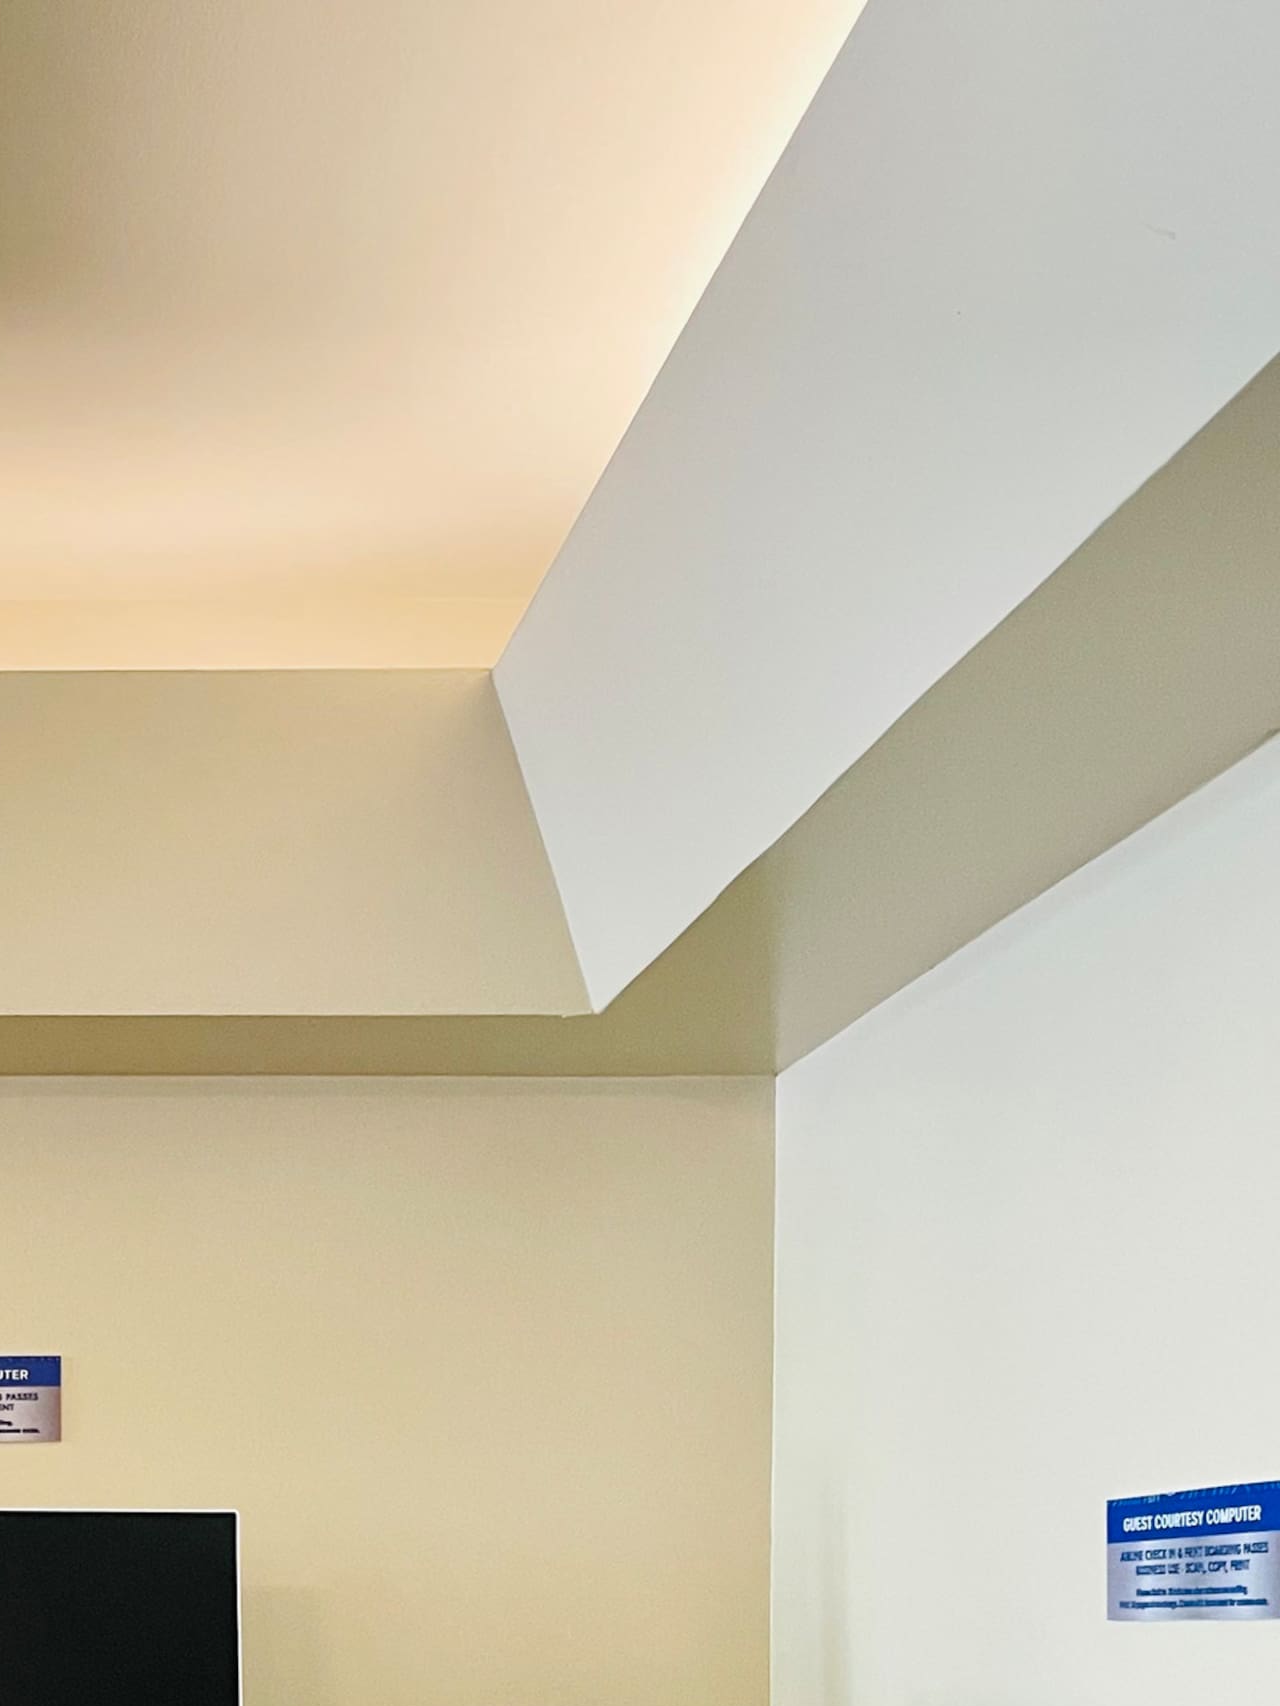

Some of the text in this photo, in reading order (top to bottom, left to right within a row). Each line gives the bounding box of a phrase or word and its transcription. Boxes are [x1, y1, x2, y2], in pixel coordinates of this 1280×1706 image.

[6, 1392, 39, 1401] PASSES
[1123, 1505, 1262, 1532] GUEST COURTESY COMPUTER
